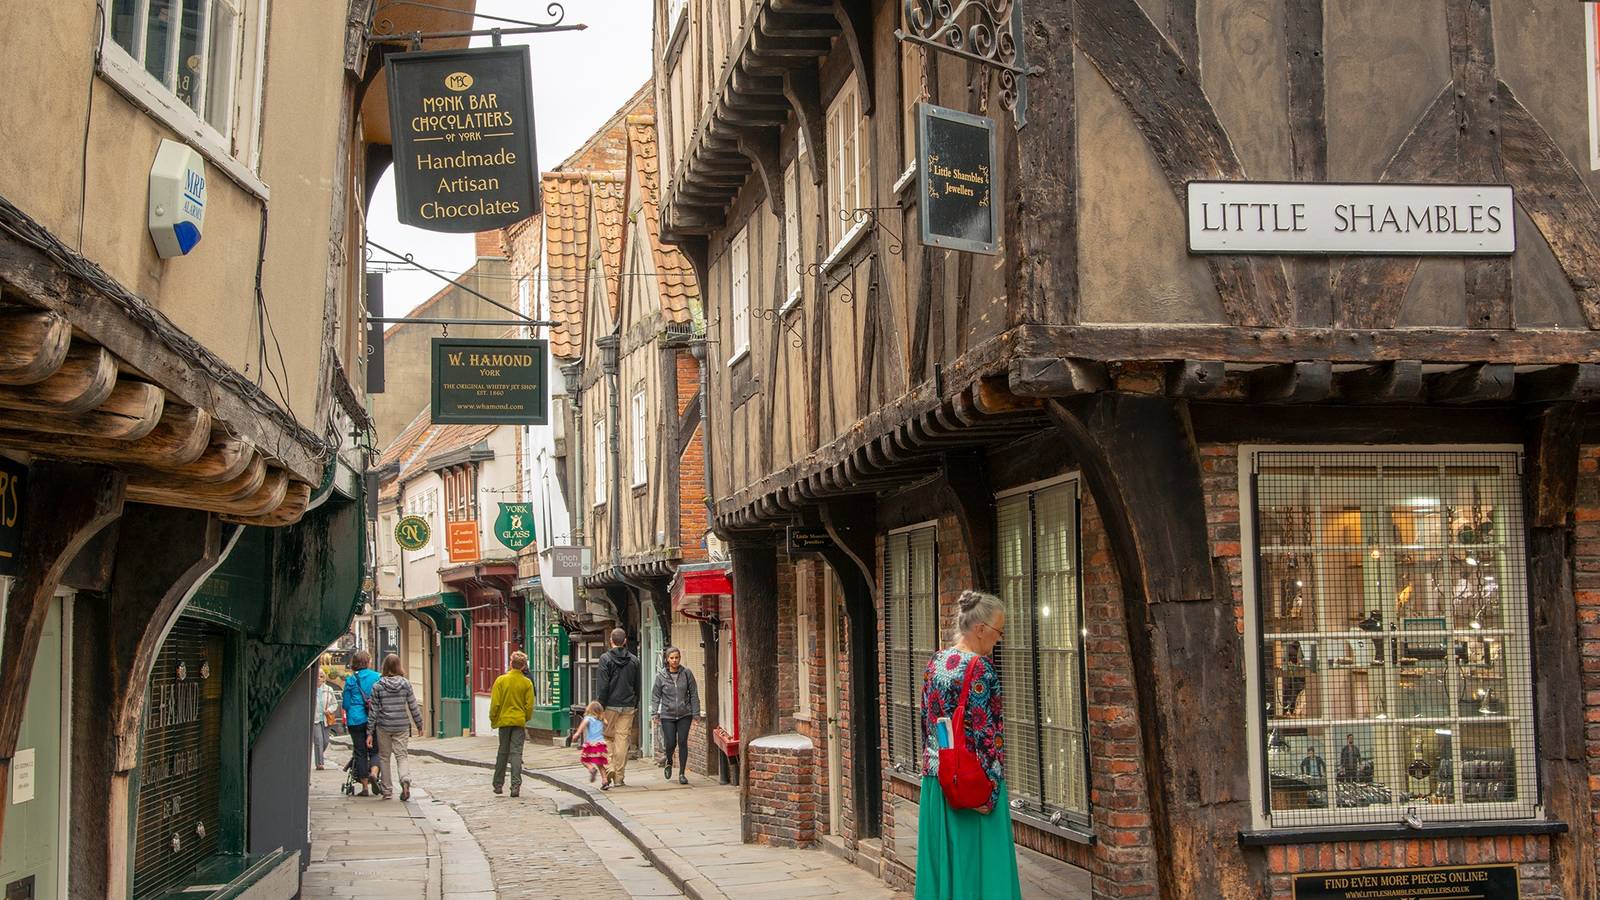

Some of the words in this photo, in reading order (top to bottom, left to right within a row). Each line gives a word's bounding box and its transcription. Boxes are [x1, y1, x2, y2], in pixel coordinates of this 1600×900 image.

[424, 96, 464, 112] MONK
[470, 94, 498, 110] BAR
[412, 112, 512, 132] CHOCOLATIERS
[458, 132, 482, 142] YORK
[417, 148, 516, 170] Handmade
[184, 168, 205, 198] MRP
[934, 165, 952, 178] Little
[953, 168, 984, 184] Shambles
[437, 176, 499, 193] Artisan
[944, 182, 974, 197] Jewellers
[420, 198, 520, 219] Chocolates
[1201, 202, 1308, 232] LITTLE
[1334, 204, 1501, 234] SHAMBLES
[448, 352, 466, 366] W.
[470, 354, 532, 366] HAMOND
[480, 368, 500, 376] YORK
[506, 505, 528, 514] YORK
[1325, 878, 1349, 889] FIND
[1350, 876, 1378, 888] EVEN
[1380, 875, 1408, 886] MORE
[1412, 873, 1446, 884] PIECES
[1448, 872, 1488, 882] ONLINE!
